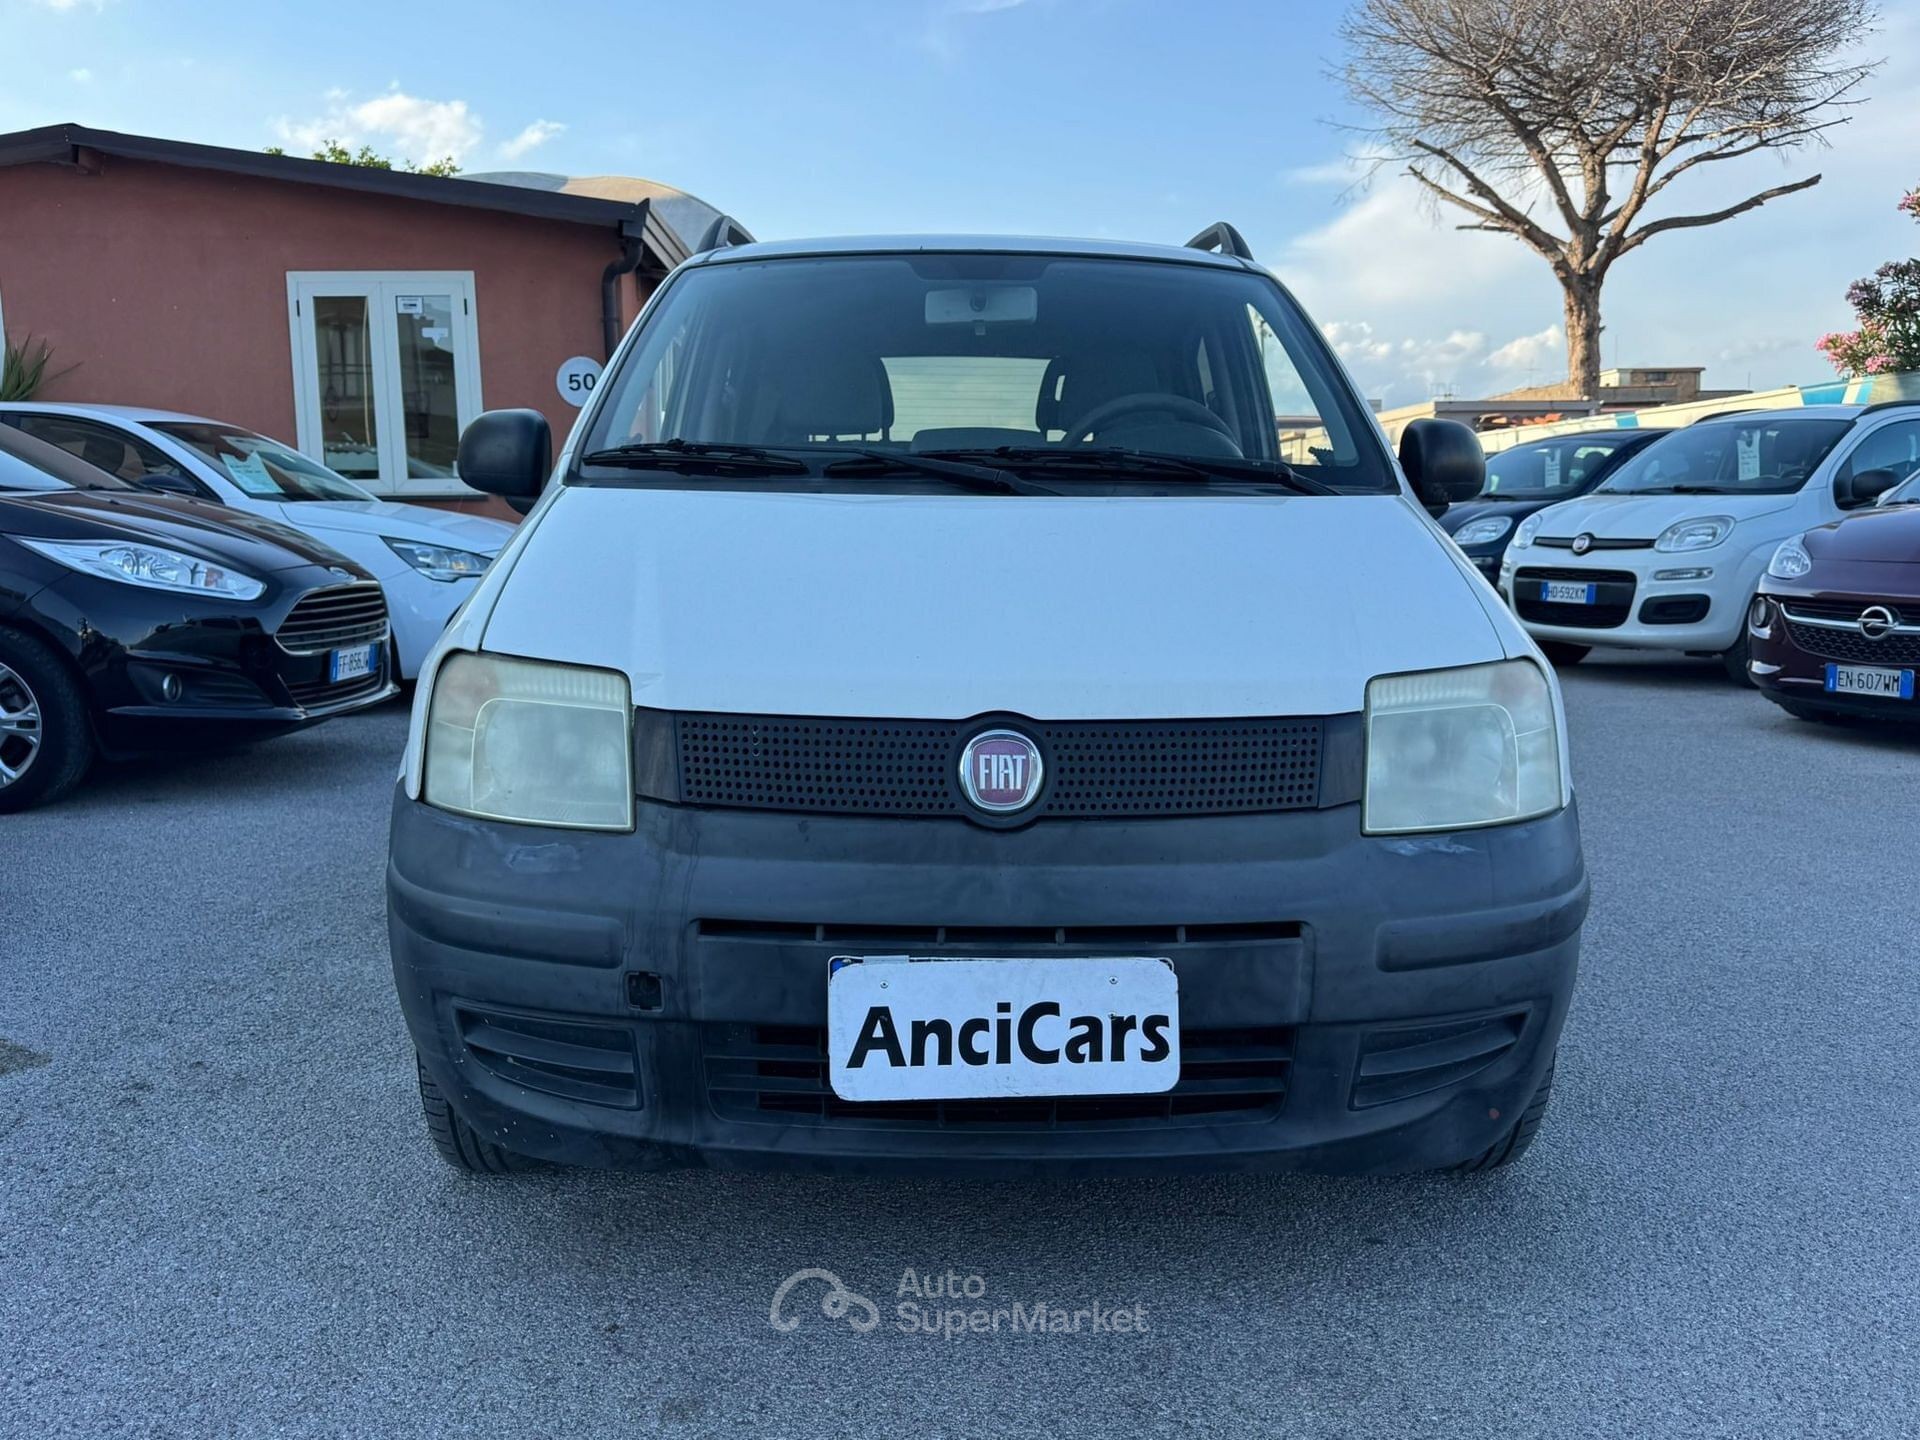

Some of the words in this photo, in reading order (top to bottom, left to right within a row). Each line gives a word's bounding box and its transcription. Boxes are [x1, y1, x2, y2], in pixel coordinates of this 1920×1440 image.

[568, 373, 596, 391] 50
[979, 754, 1026, 790] FIAT
[846, 1001, 1170, 1069] AnciCars
